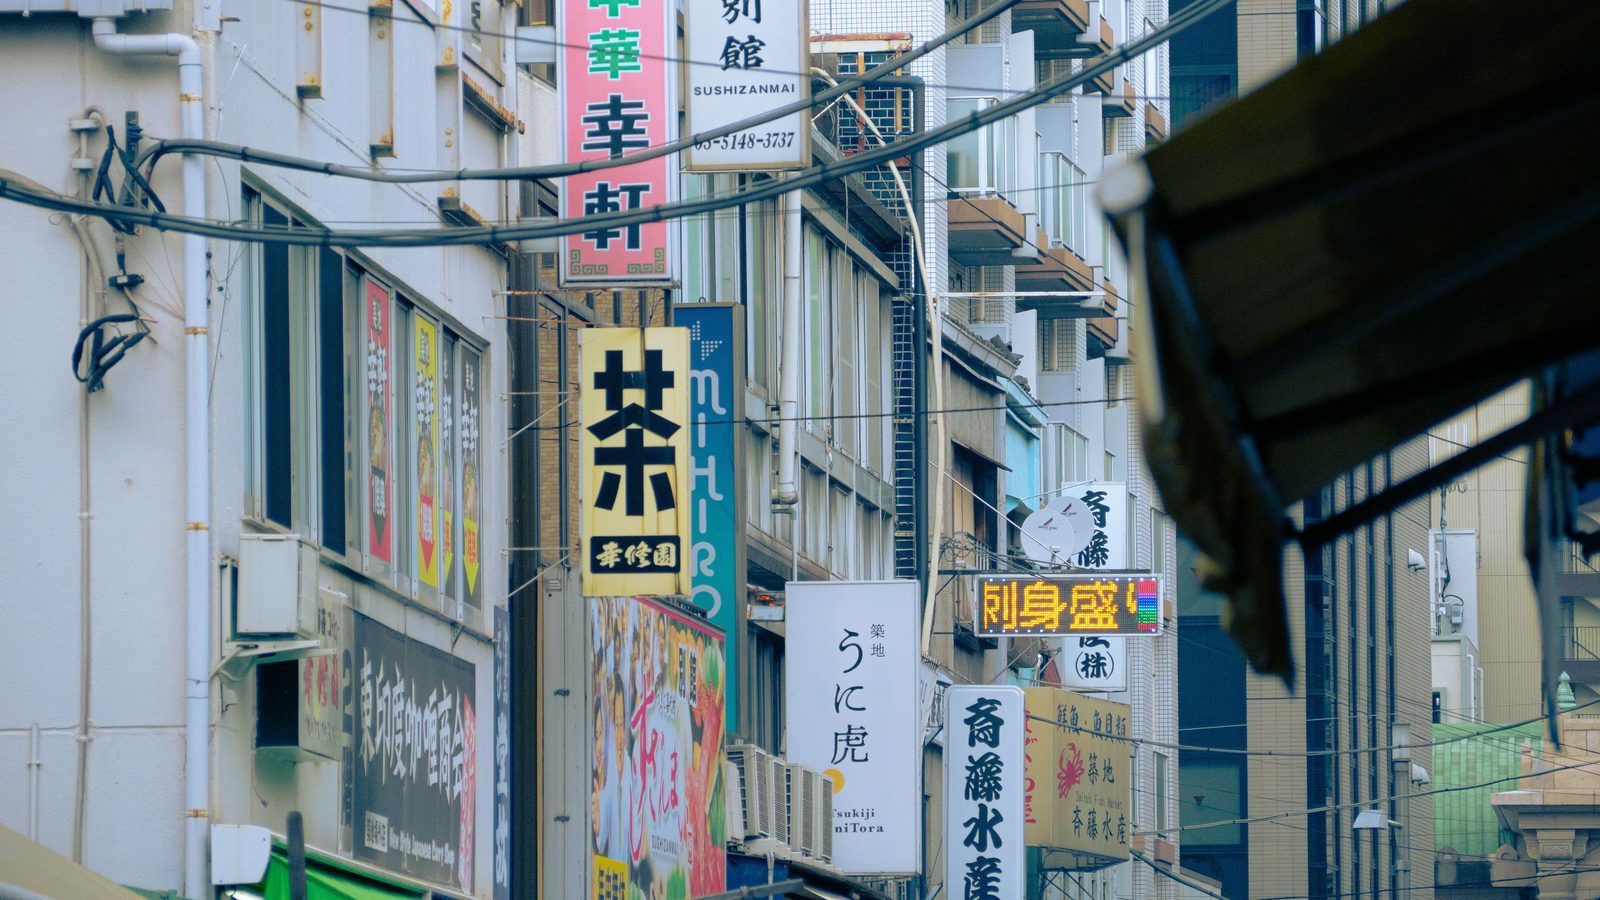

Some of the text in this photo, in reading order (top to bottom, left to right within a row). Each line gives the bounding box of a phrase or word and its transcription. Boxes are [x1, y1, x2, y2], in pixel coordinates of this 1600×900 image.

[720, 0, 766, 71] 別館
[693, 83, 796, 96] SUSHIZANMAI
[586, 349, 682, 517] 茶
[870, 623, 885, 658] 築地
[831, 628, 869, 765] うに虎
[1087, 752, 1115, 786] 築地
[834, 822, 885, 833] niTora
